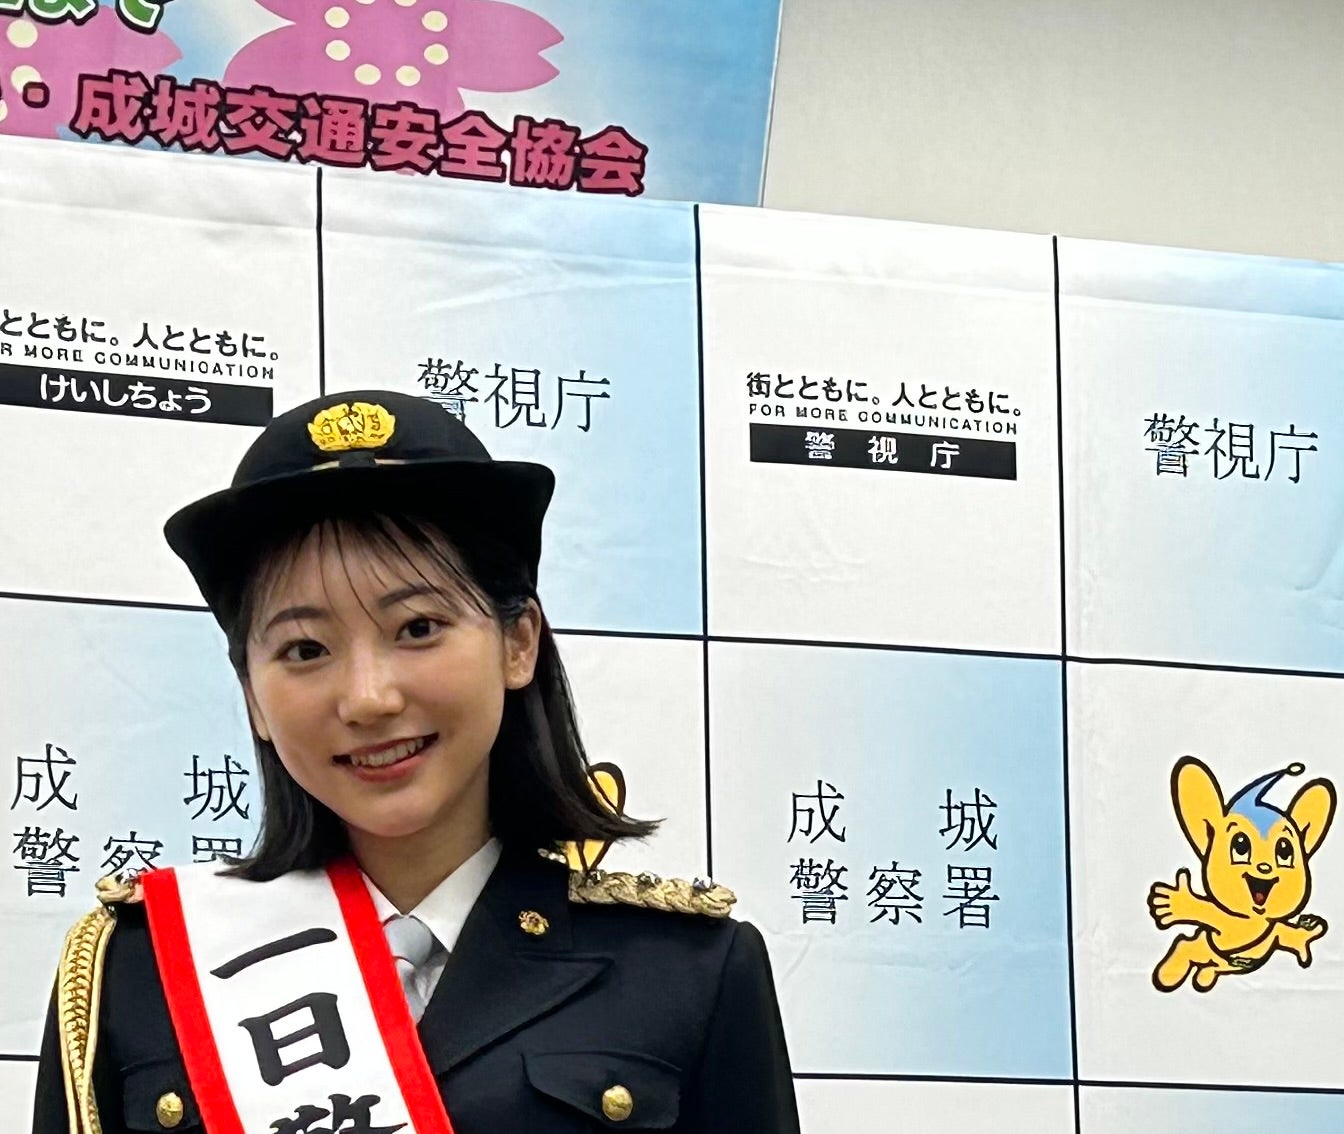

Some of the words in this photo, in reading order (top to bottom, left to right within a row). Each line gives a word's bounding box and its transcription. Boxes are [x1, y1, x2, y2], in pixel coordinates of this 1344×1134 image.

[25, 345, 83, 362] MORE
[95, 352, 273, 379] COMMUNICATION
[40, 374, 212, 414] けいしちょう
[418, 358, 610, 432] 警視庁
[747, 372, 1020, 416] 街とともに。人とともに。
[750, 404, 785, 417] FOR
[797, 407, 847, 421] MORE
[859, 412, 1016, 434] COMMUNICATION
[805, 432, 959, 468] 警視庁
[1144, 413, 1318, 484] 警視庁
[790, 858, 1000, 928] 警察署
